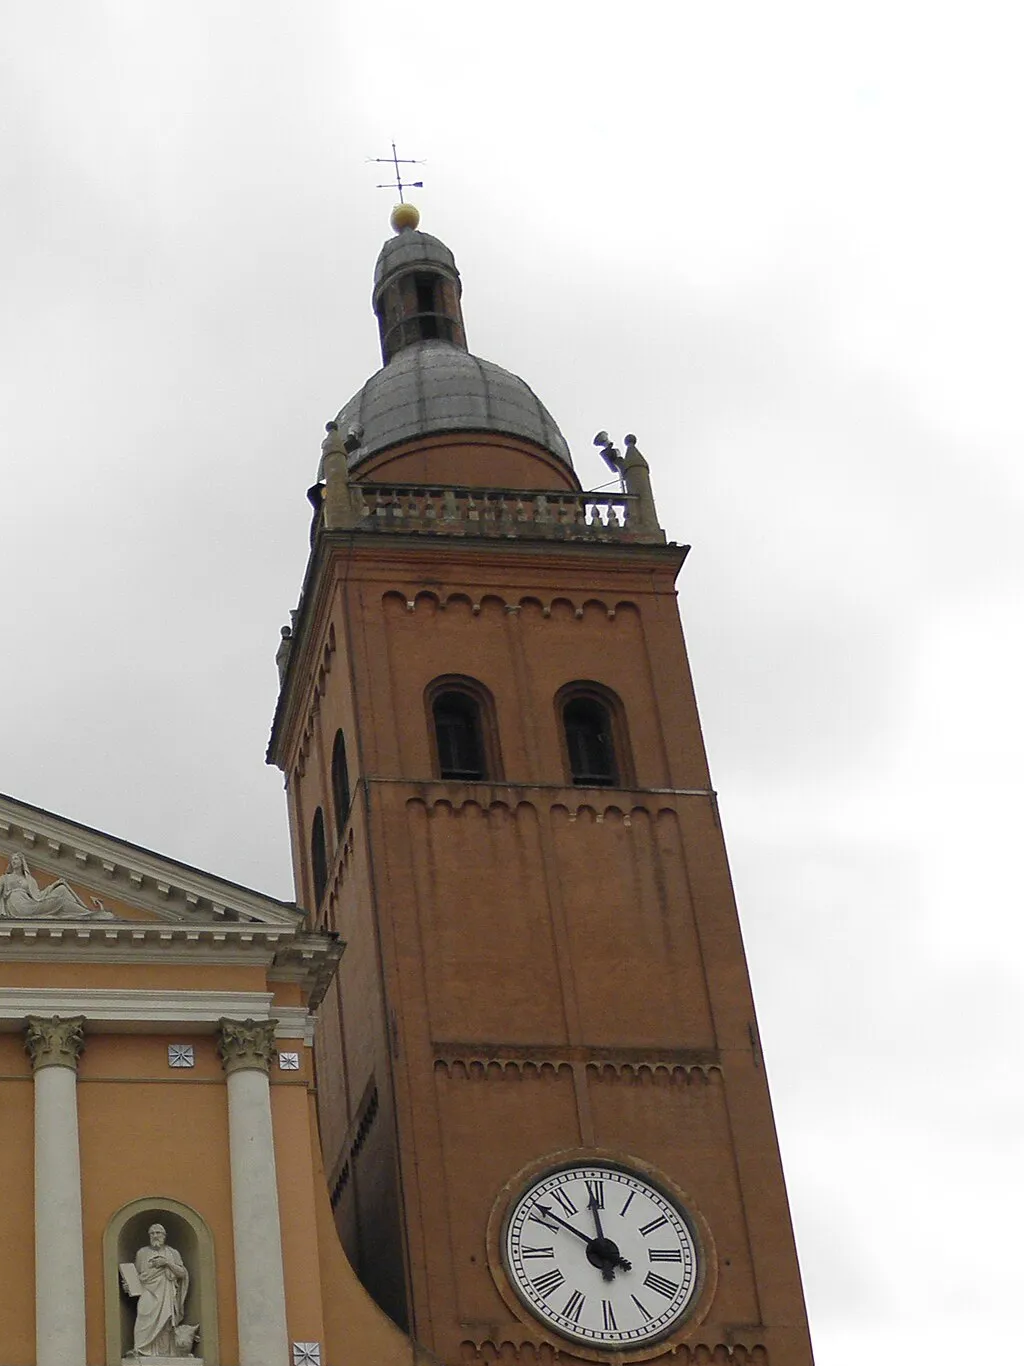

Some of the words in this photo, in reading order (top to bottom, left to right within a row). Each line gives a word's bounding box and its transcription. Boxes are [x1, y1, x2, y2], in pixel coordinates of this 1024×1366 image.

[549, 1187, 579, 1218] XI
[584, 1180, 605, 1210] XII
[619, 1190, 636, 1216] I
[529, 1212, 559, 1234] X
[639, 1214, 668, 1236] II
[521, 1245, 554, 1259] IX
[648, 1248, 681, 1263] III
[531, 1269, 565, 1299] VIII
[643, 1271, 679, 1300] IIII
[561, 1289, 586, 1323] VII
[602, 1300, 618, 1330] VI
[631, 1294, 653, 1322] V
